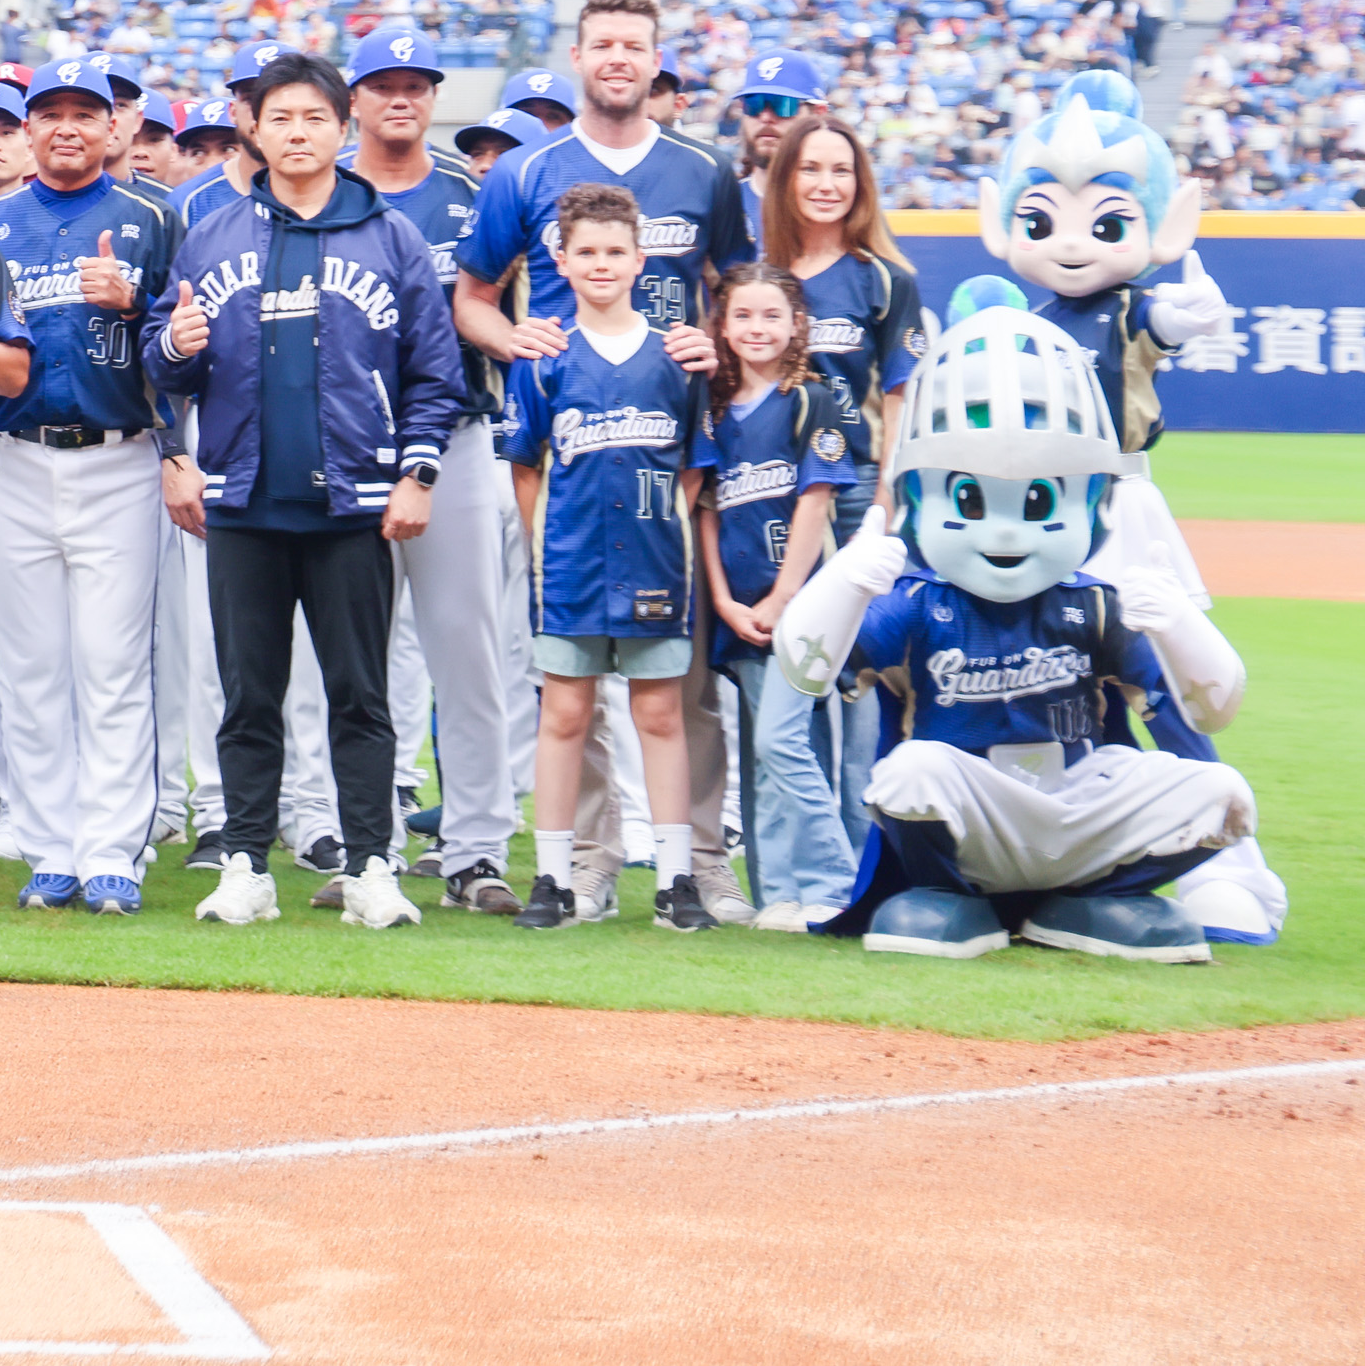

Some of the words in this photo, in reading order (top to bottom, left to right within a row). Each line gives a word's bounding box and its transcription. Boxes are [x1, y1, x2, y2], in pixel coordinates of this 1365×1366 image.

[0, 64, 20, 80] R
[320, 256, 399, 331] DIANS
[638, 275, 686, 324] 39
[86, 316, 131, 369] 30
[553, 406, 678, 466] Guardians
[636, 468, 675, 521] 17
